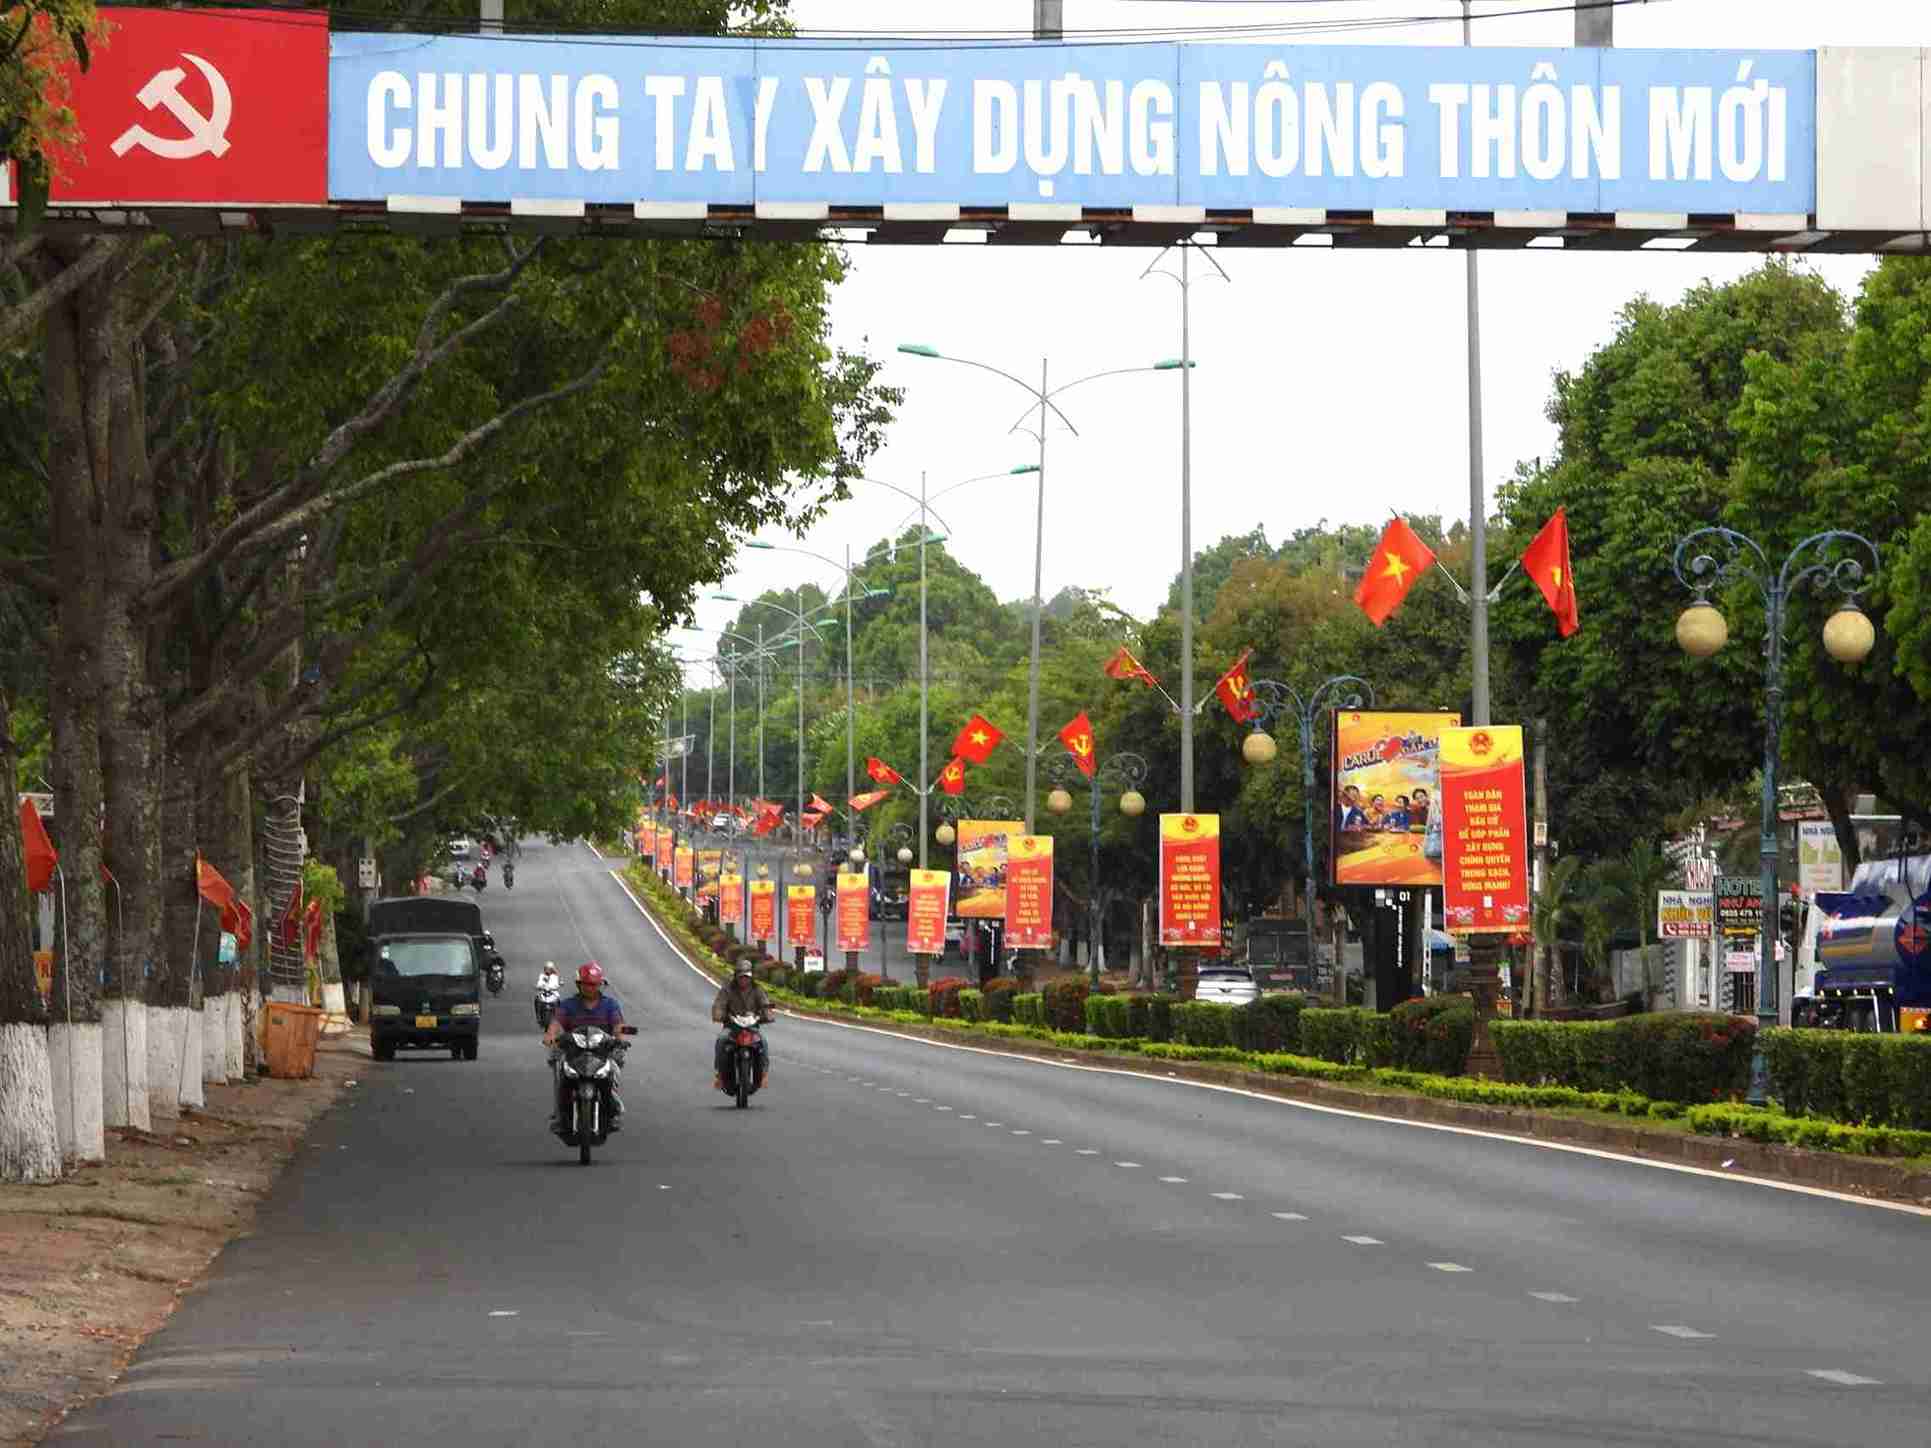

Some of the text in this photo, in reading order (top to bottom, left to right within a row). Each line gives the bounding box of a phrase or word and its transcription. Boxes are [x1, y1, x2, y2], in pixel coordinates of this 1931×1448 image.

[367, 56, 1787, 197] CHUNG TAY XÂY DỰNG NÔNG THÔN MỚI
[1718, 879, 1761, 896] HOTE
